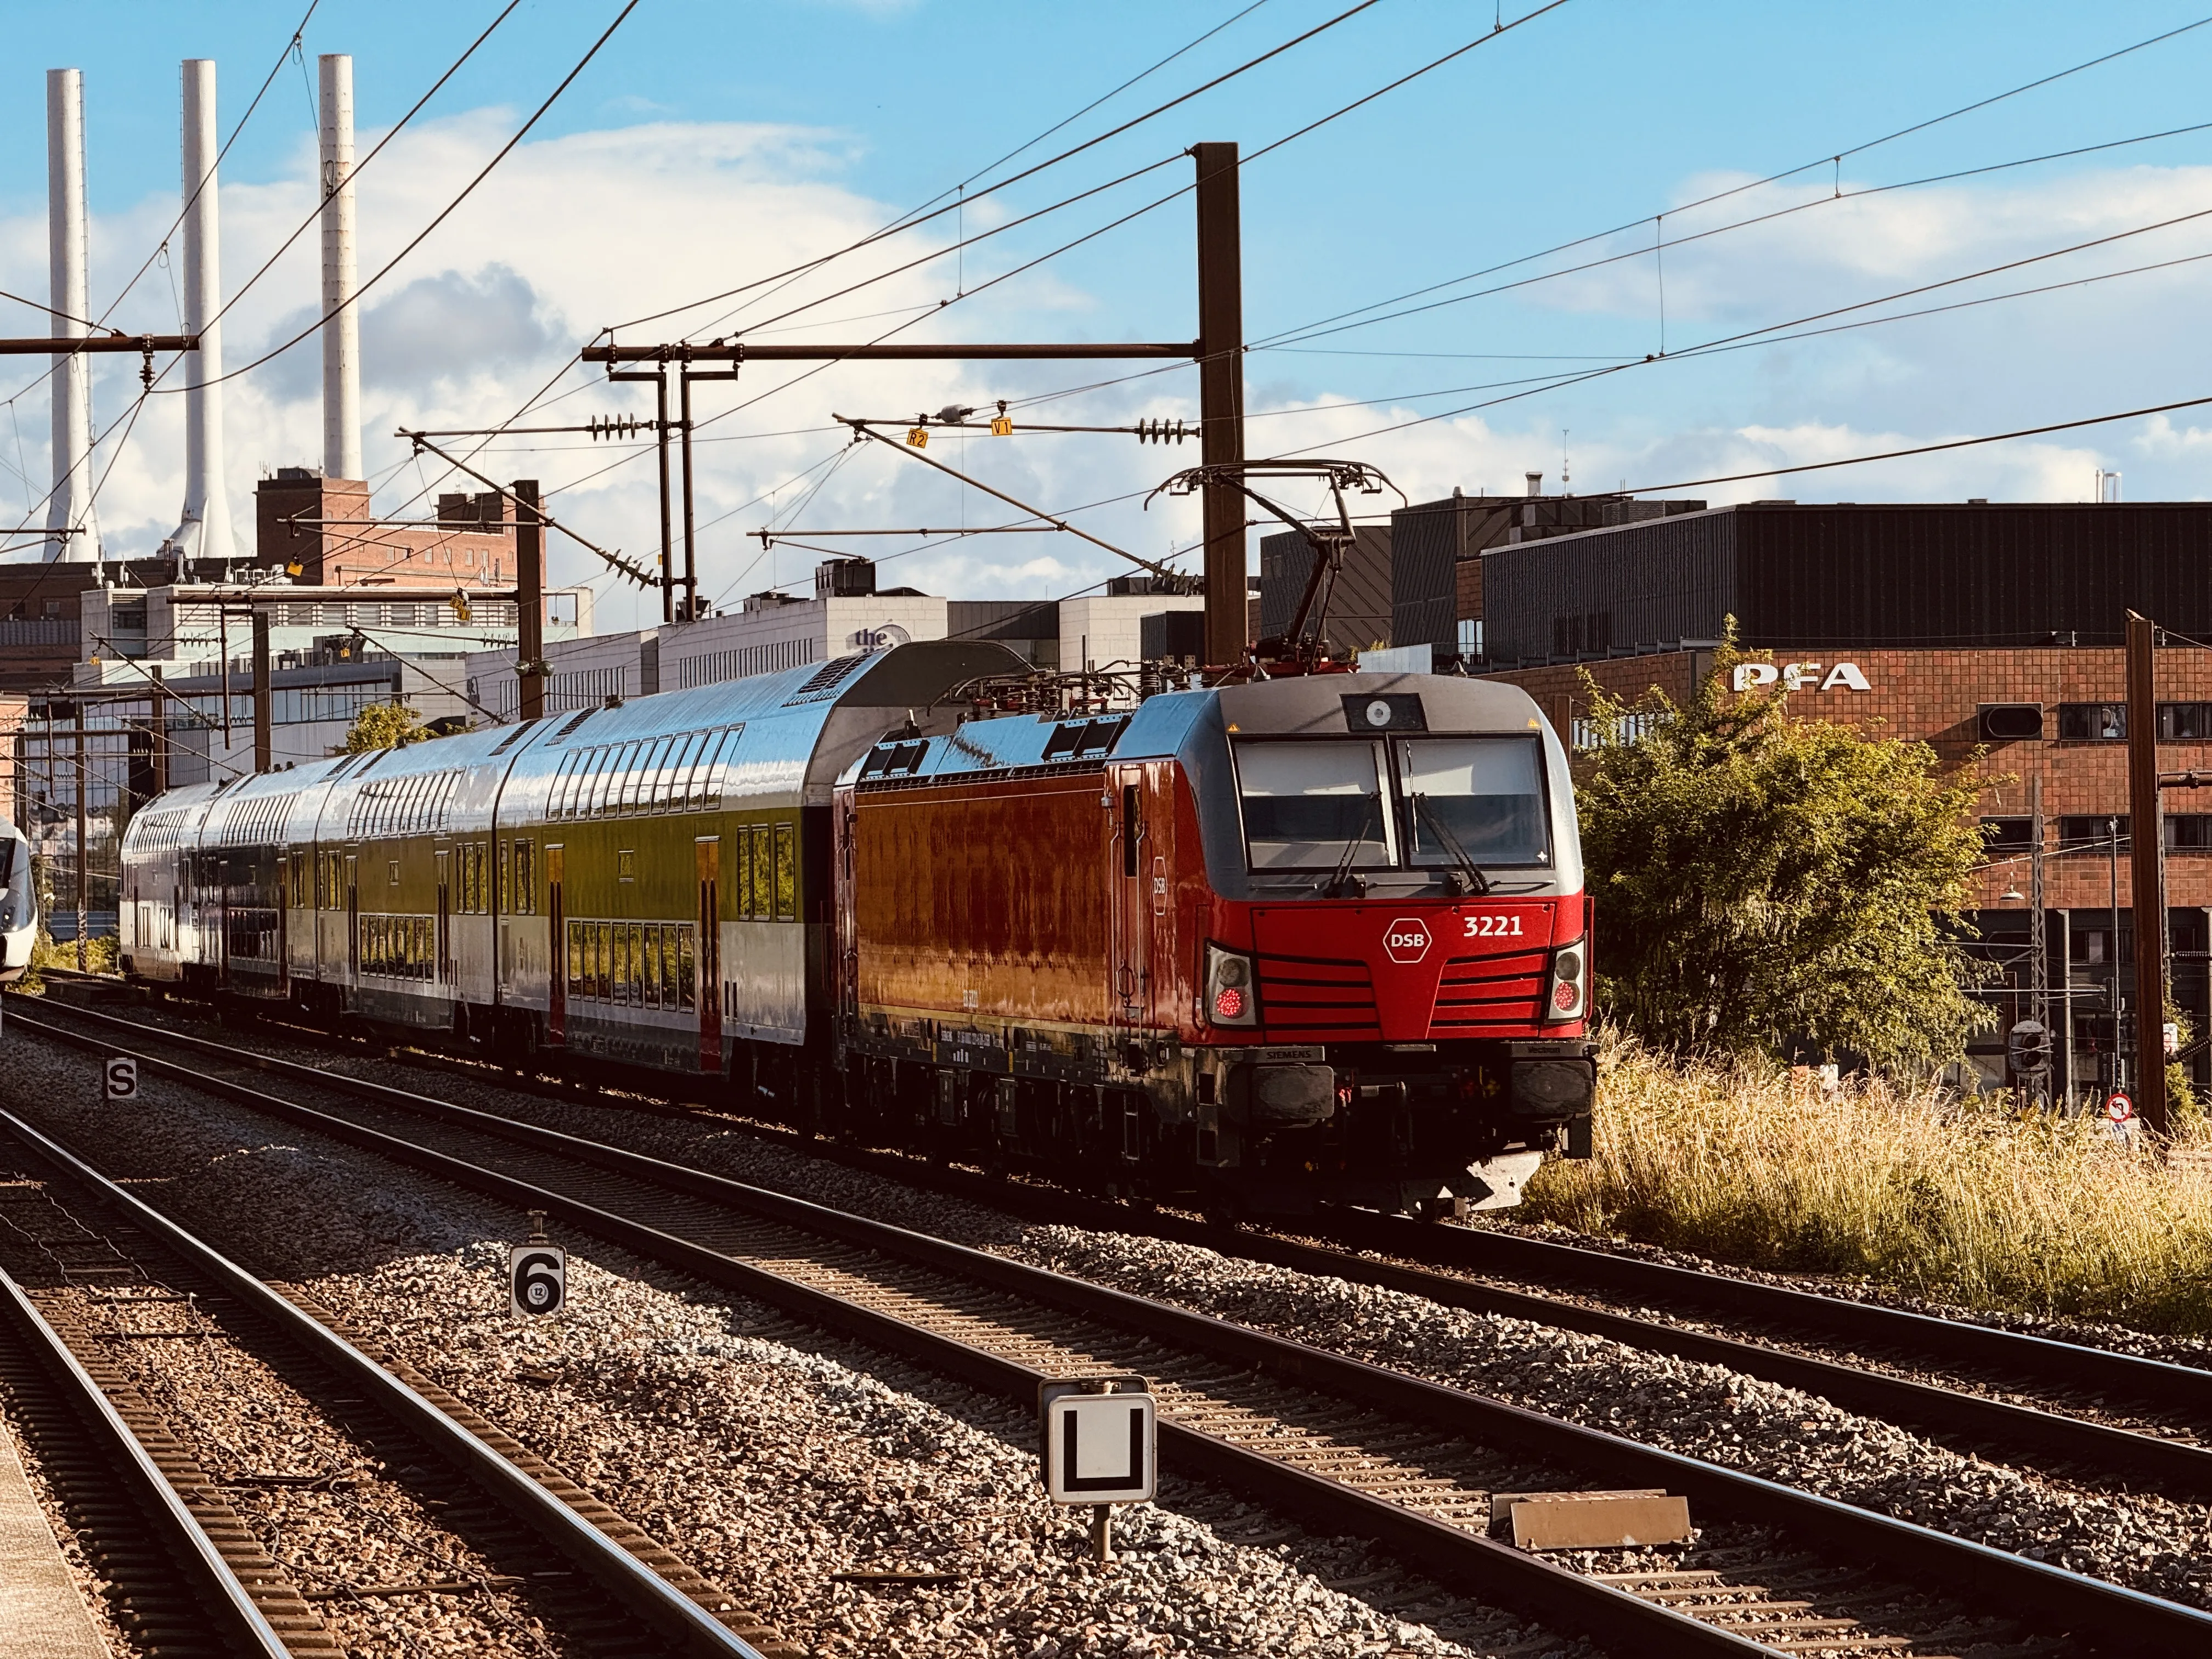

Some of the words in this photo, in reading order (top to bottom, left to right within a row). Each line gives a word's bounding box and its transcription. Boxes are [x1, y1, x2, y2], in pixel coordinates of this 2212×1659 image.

[909, 432, 924, 447] R2
[856, 628, 887, 645] the
[1734, 662, 1872, 691] PFA
[1154, 877, 1166, 894] DSB
[1463, 915, 1523, 937] 3221
[1391, 934, 1425, 947] DSB
[1266, 1050, 1311, 1059] SIEMENS
[109, 1064, 135, 1096] S
[514, 1253, 561, 1314] 6
[534, 1287, 543, 1296] 12
